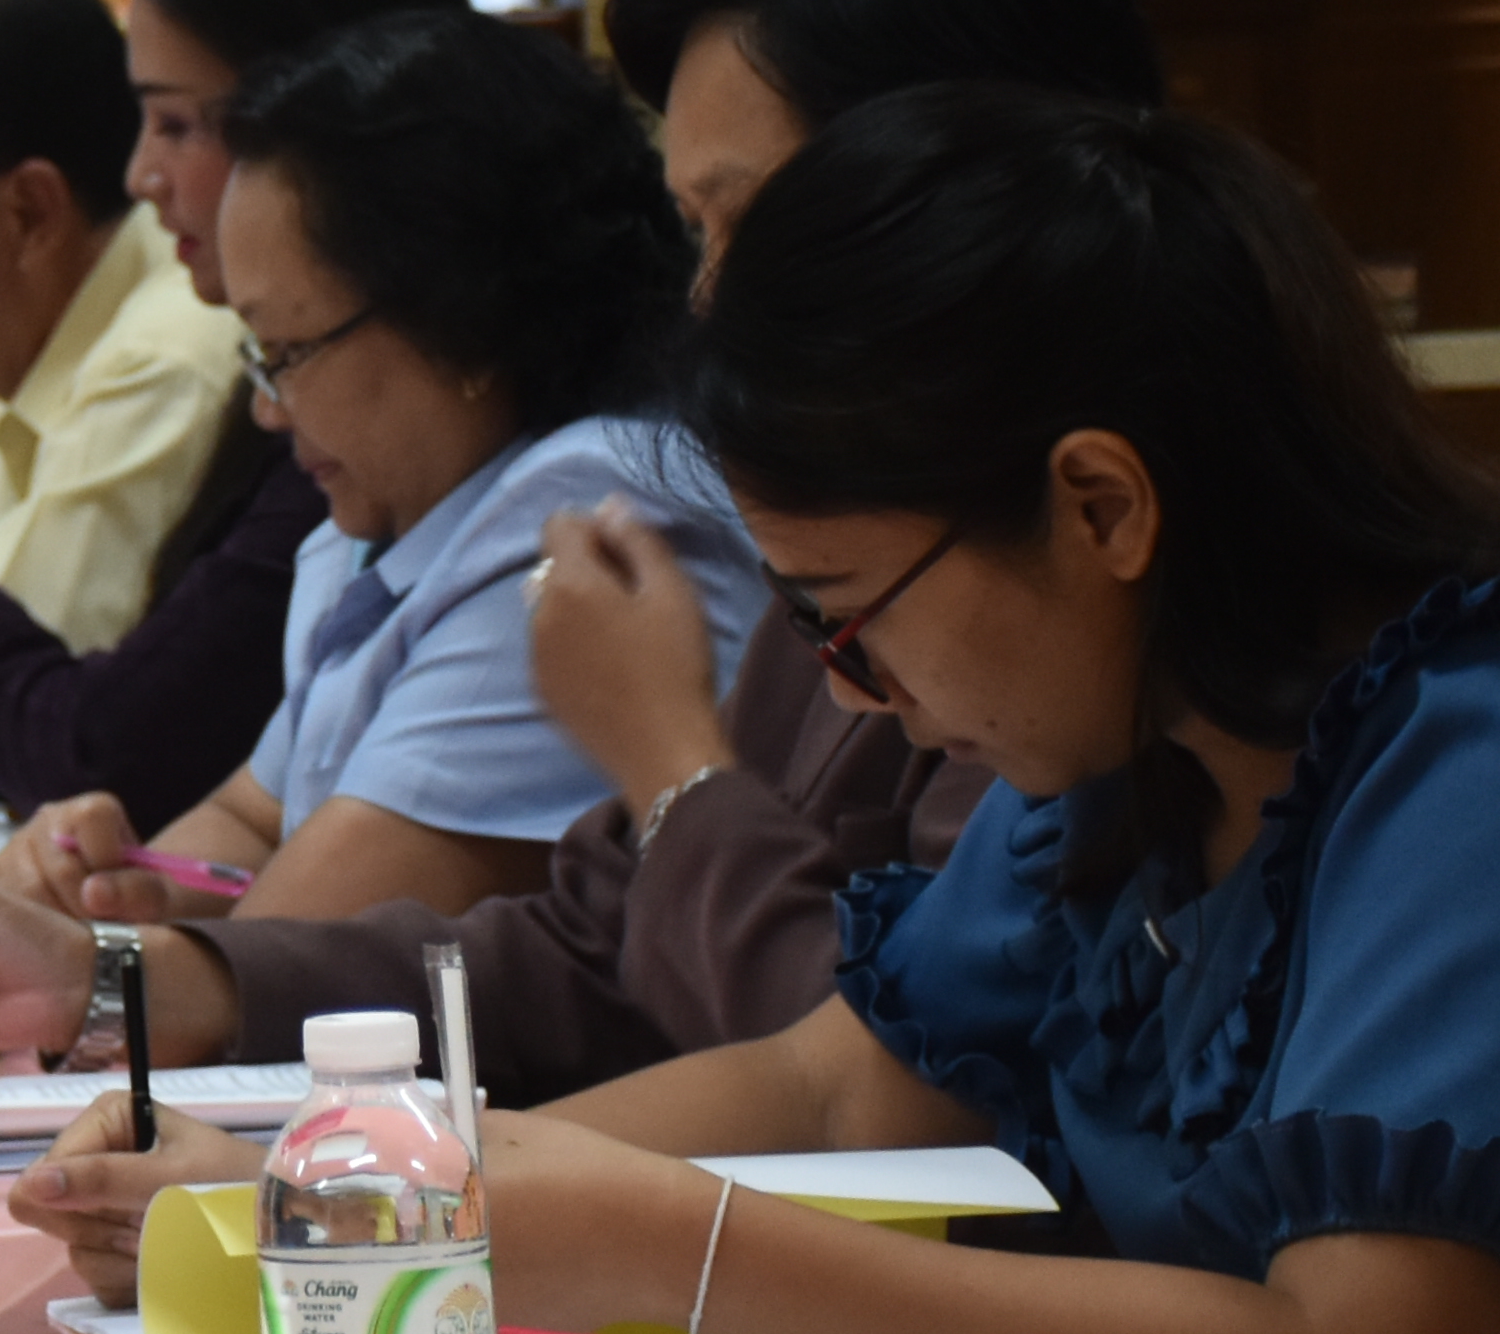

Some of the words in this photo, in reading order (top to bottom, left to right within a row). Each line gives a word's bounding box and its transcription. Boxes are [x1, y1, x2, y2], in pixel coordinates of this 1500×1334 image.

[304, 1279, 358, 1300] Chang
[297, 1303, 342, 1312] DRINKING
[303, 1314, 335, 1323] WATER
